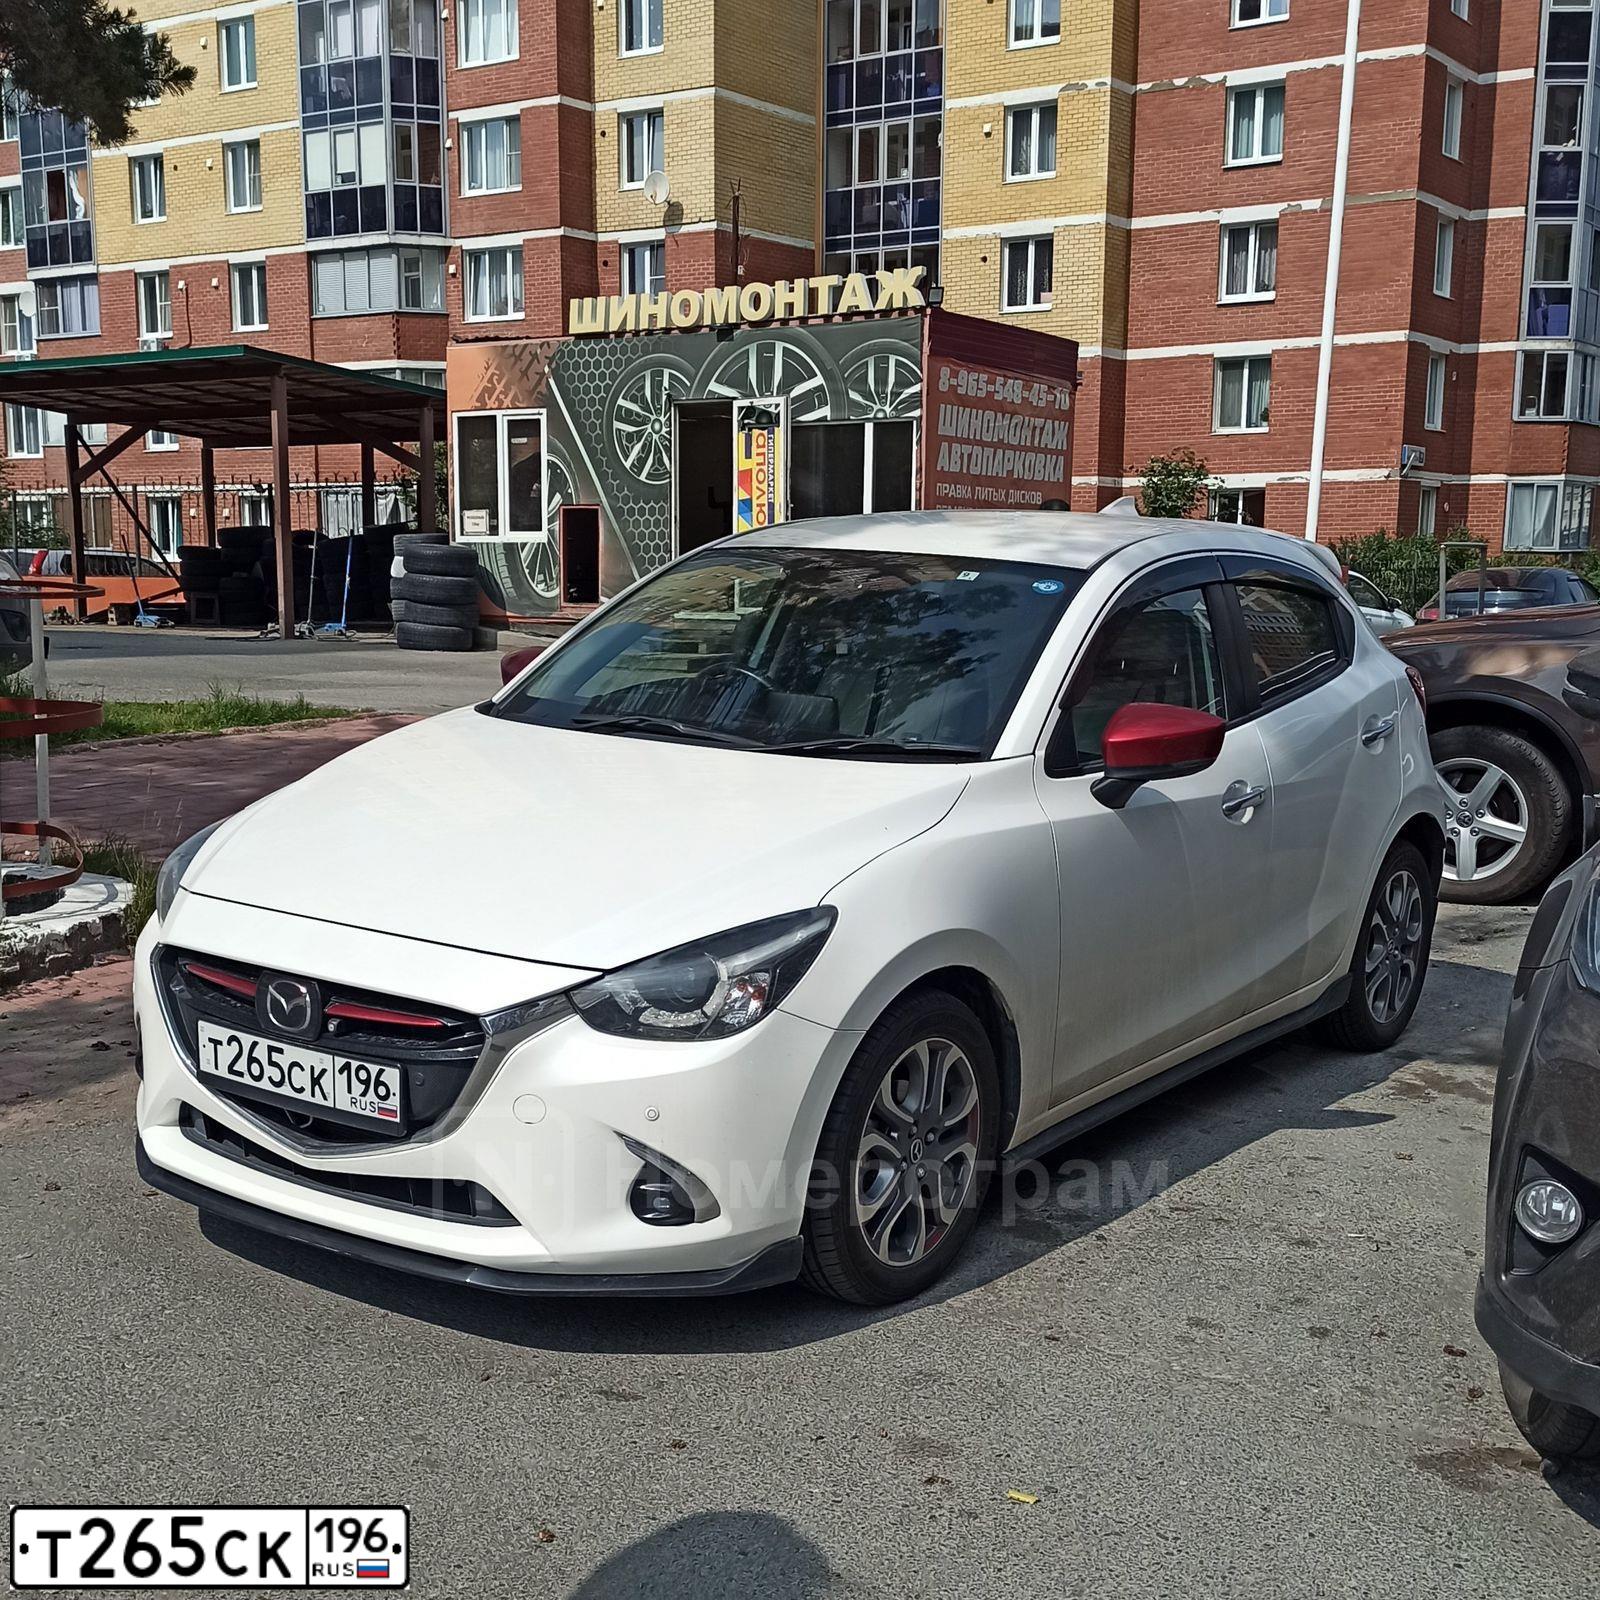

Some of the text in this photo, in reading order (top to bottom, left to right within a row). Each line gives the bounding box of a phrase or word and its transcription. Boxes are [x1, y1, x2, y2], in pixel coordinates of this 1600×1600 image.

[568, 265, 926, 334] ШИНОМОНТАЖ
[938, 404, 1069, 450] ШИНОМОНТАЖ
[767, 434, 775, 503] ГИПЕРМАРКЕТ
[936, 442, 1064, 482] АВТОПАРКОВКА
[936, 483, 1043, 505] ПРАВКА ЛИТЫХ ДИСКОВ
[207, 1034, 391, 1102] Т265СК 196
[350, 1096, 377, 1113] RUS
